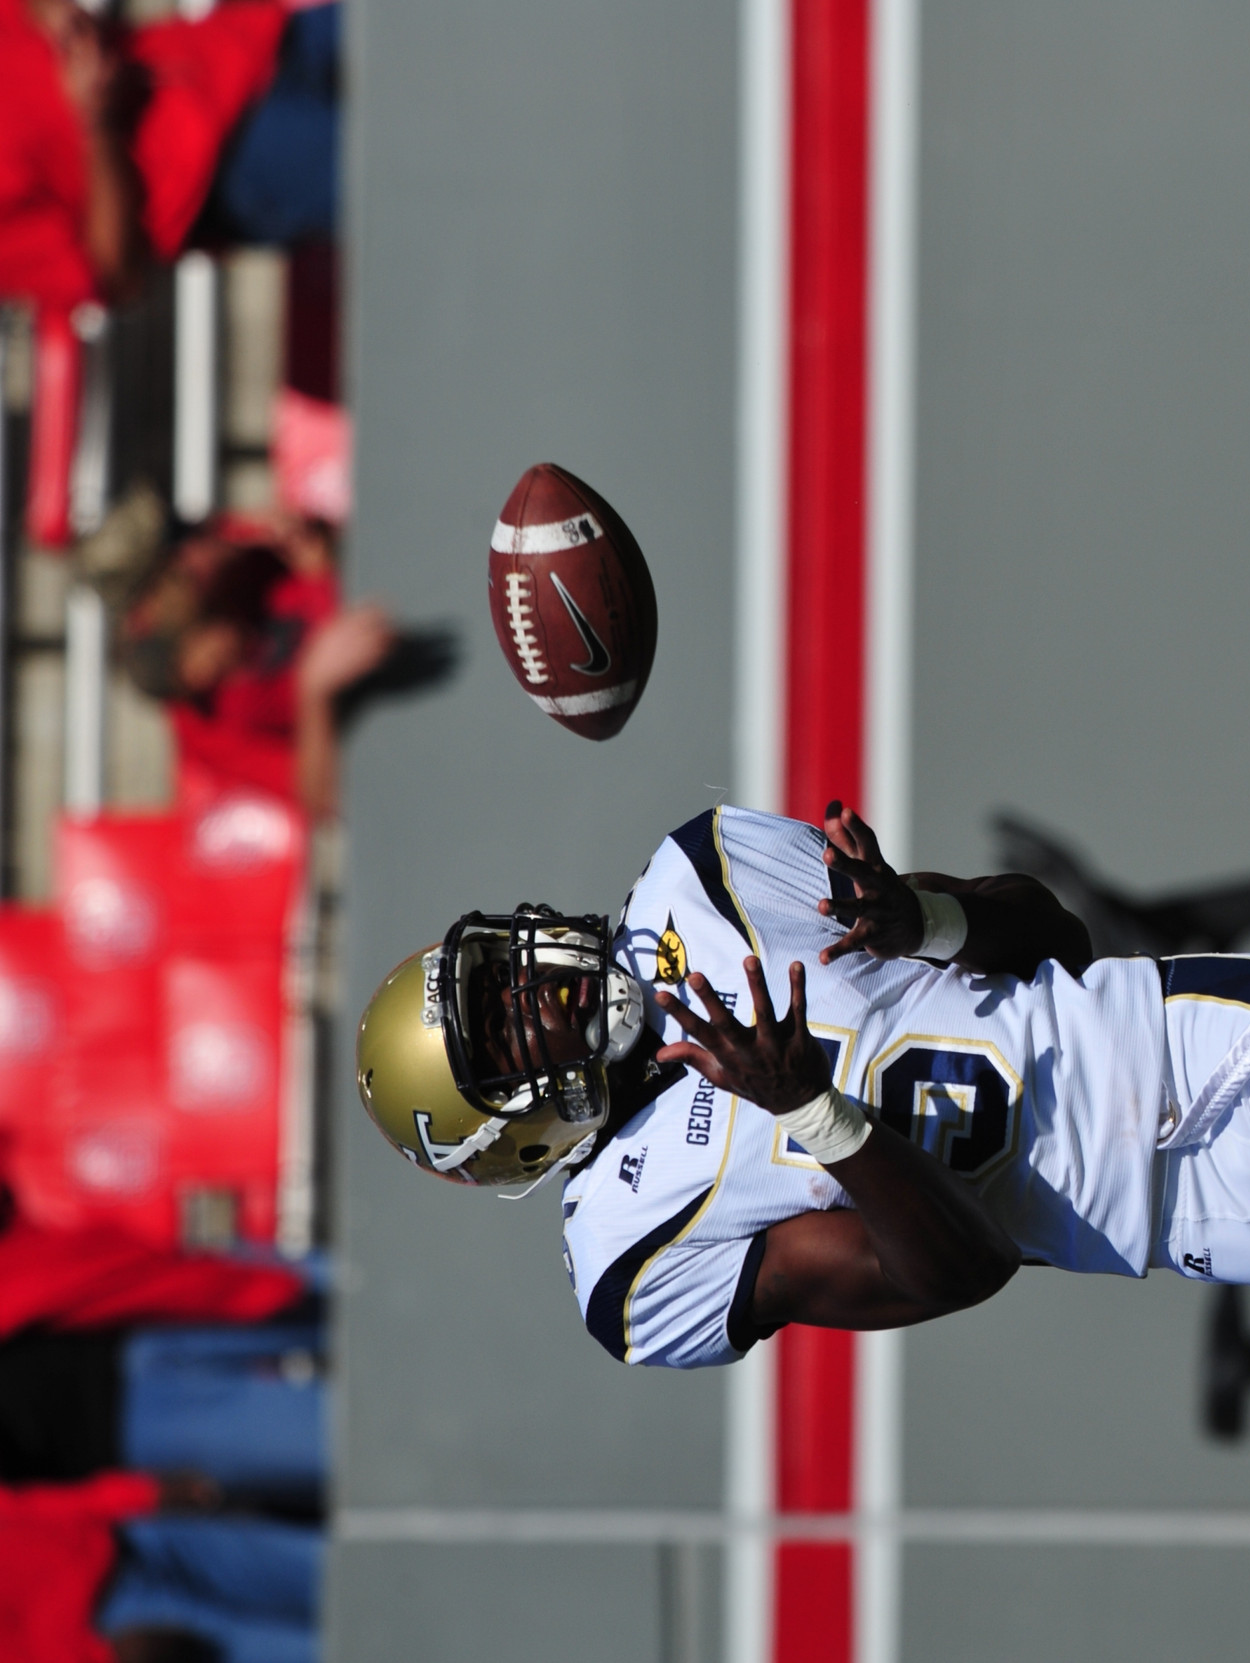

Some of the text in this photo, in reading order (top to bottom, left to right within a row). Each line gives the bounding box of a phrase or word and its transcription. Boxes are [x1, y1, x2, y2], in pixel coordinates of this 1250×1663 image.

[663, 938, 681, 984] ACC
[686, 1077, 715, 1146] GEORG
[632, 1145, 648, 1194] RUSSELL
